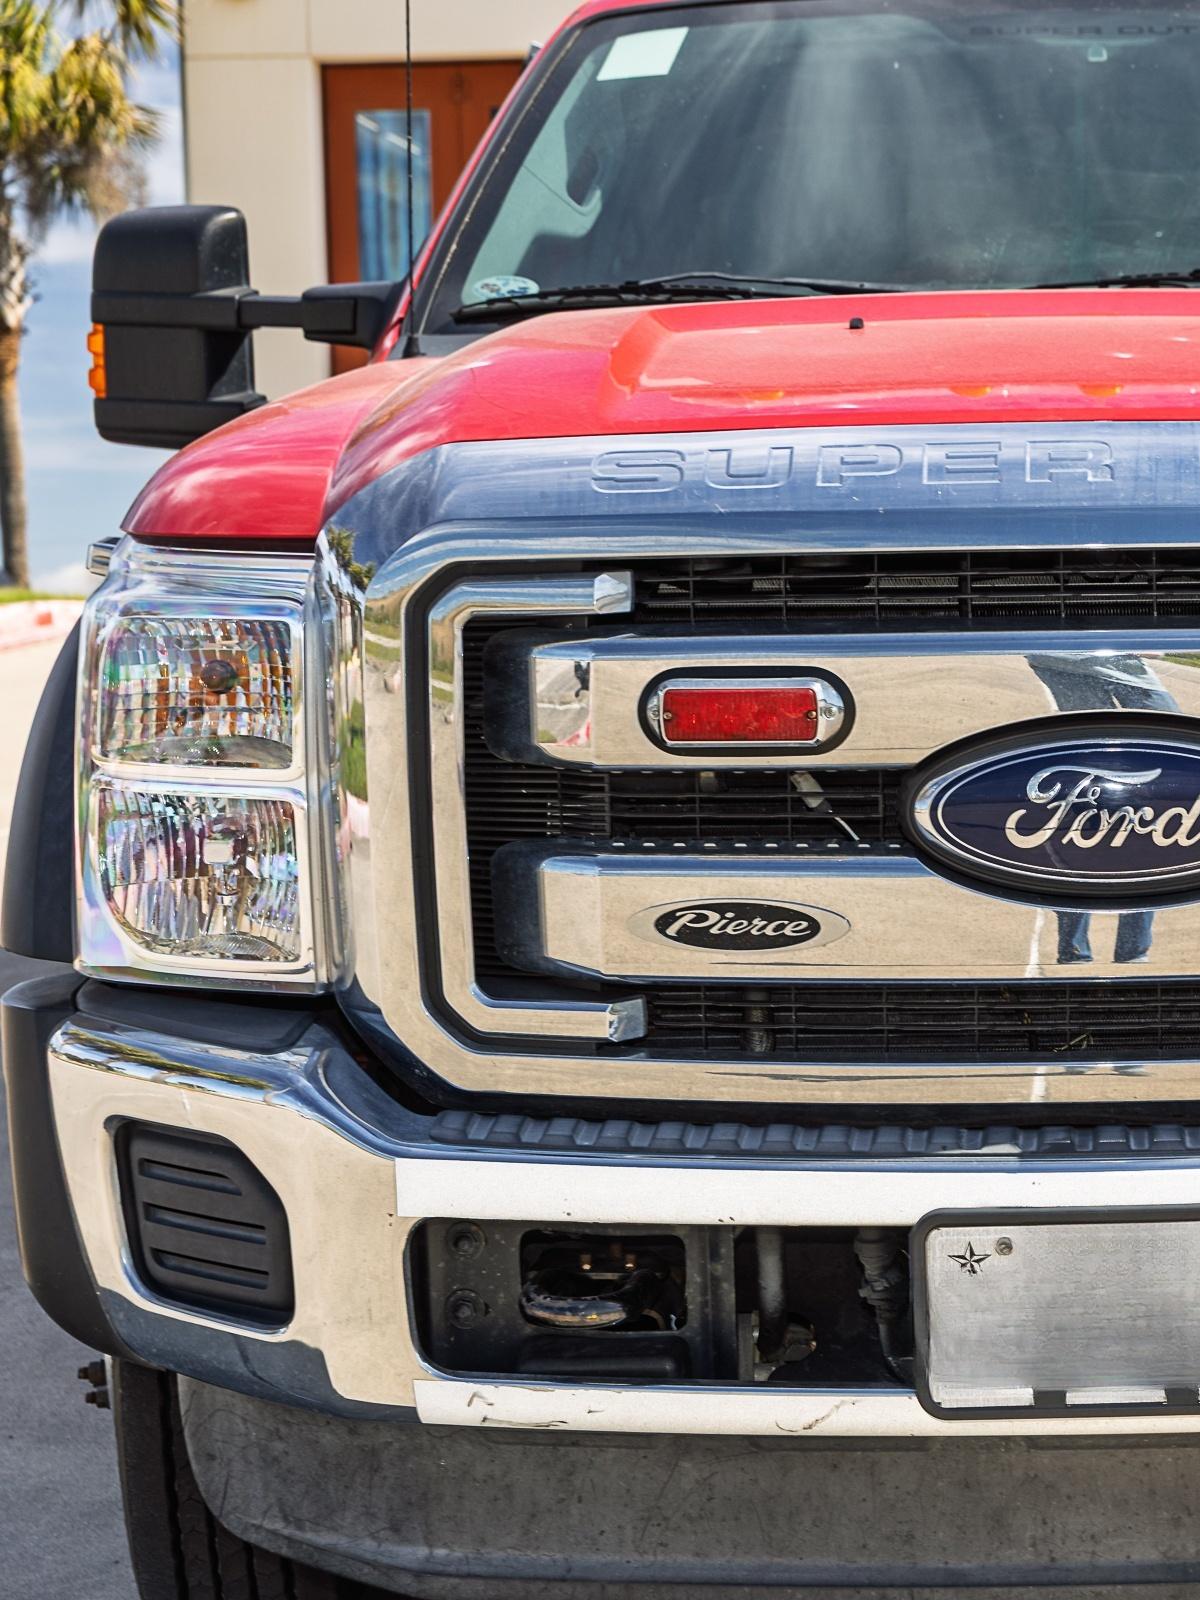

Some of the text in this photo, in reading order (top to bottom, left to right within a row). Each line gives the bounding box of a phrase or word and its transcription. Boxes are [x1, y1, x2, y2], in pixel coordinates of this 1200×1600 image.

[969, 25, 1103, 35] SUPER
[591, 439, 1115, 494] SUPER
[665, 909, 812, 937] Pierce
